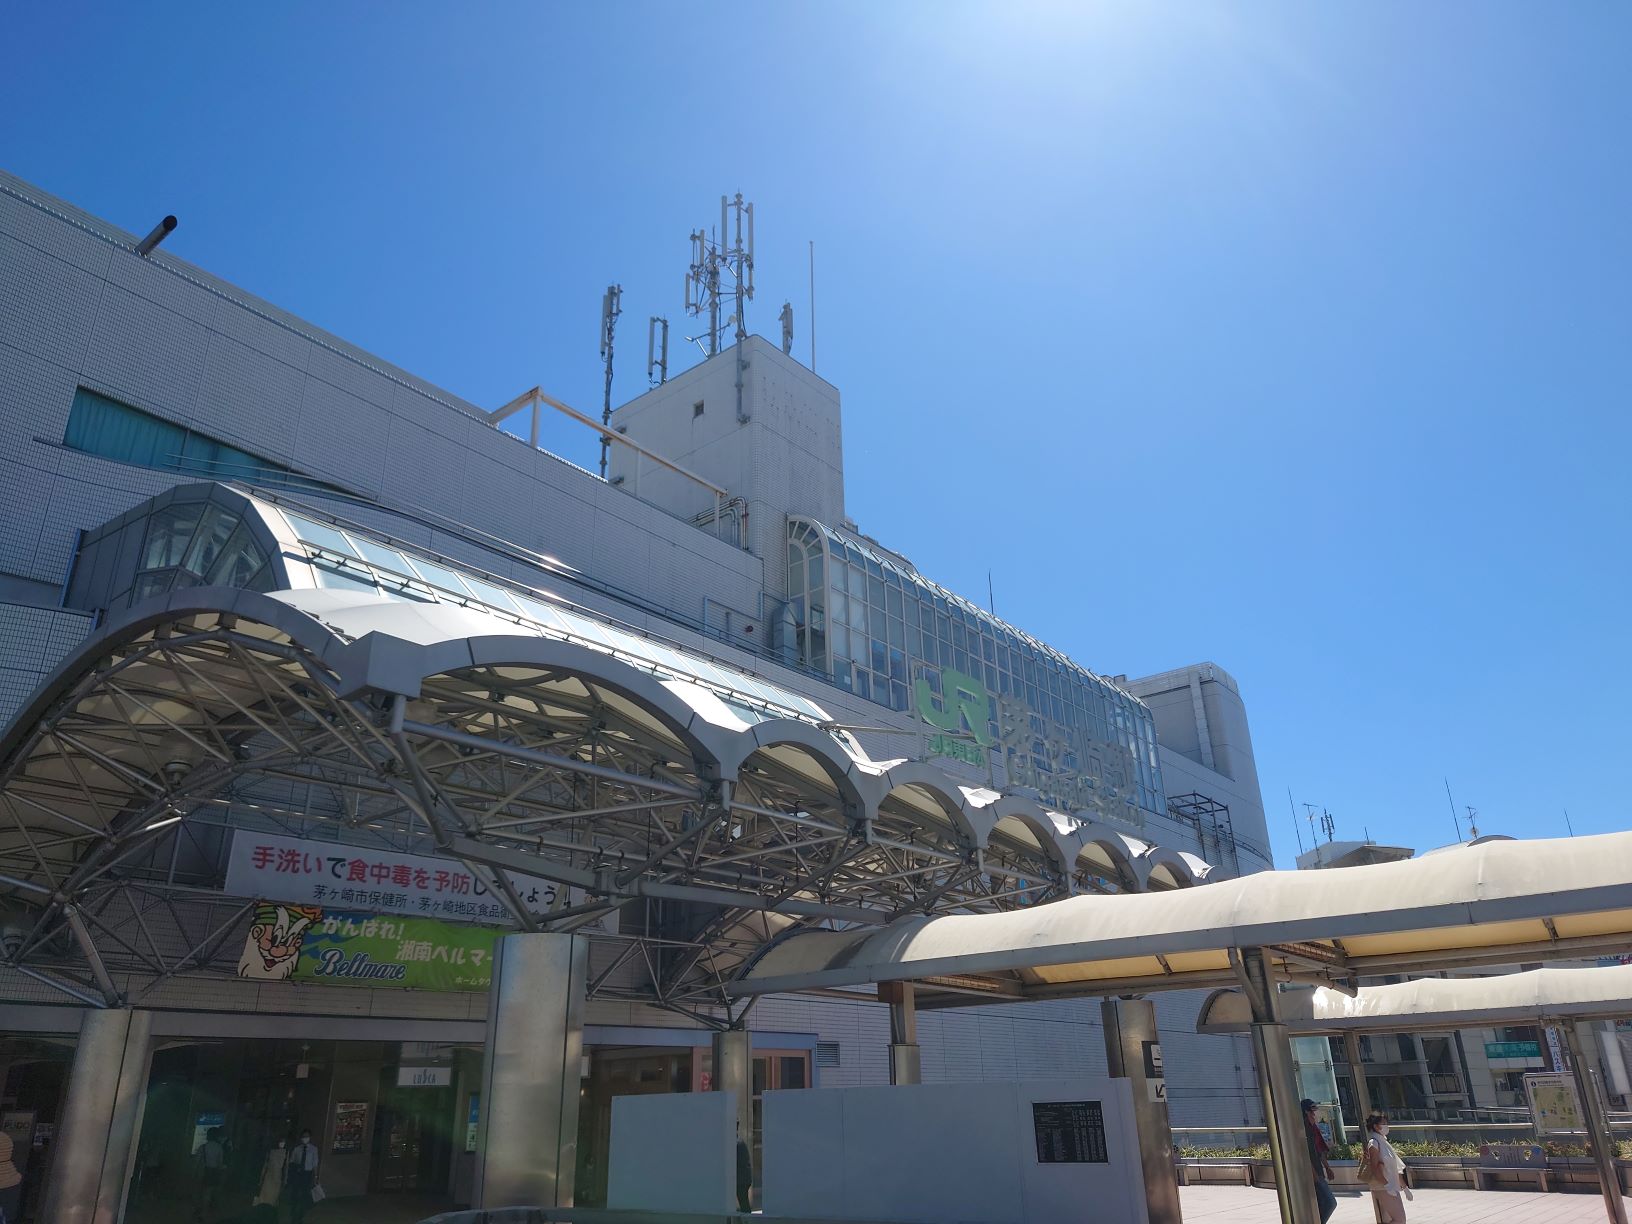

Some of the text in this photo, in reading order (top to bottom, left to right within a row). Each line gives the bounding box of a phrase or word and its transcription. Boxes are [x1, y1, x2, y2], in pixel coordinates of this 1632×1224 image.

[322, 916, 404, 942] がんばれ!
[313, 947, 408, 981] Bellmare
